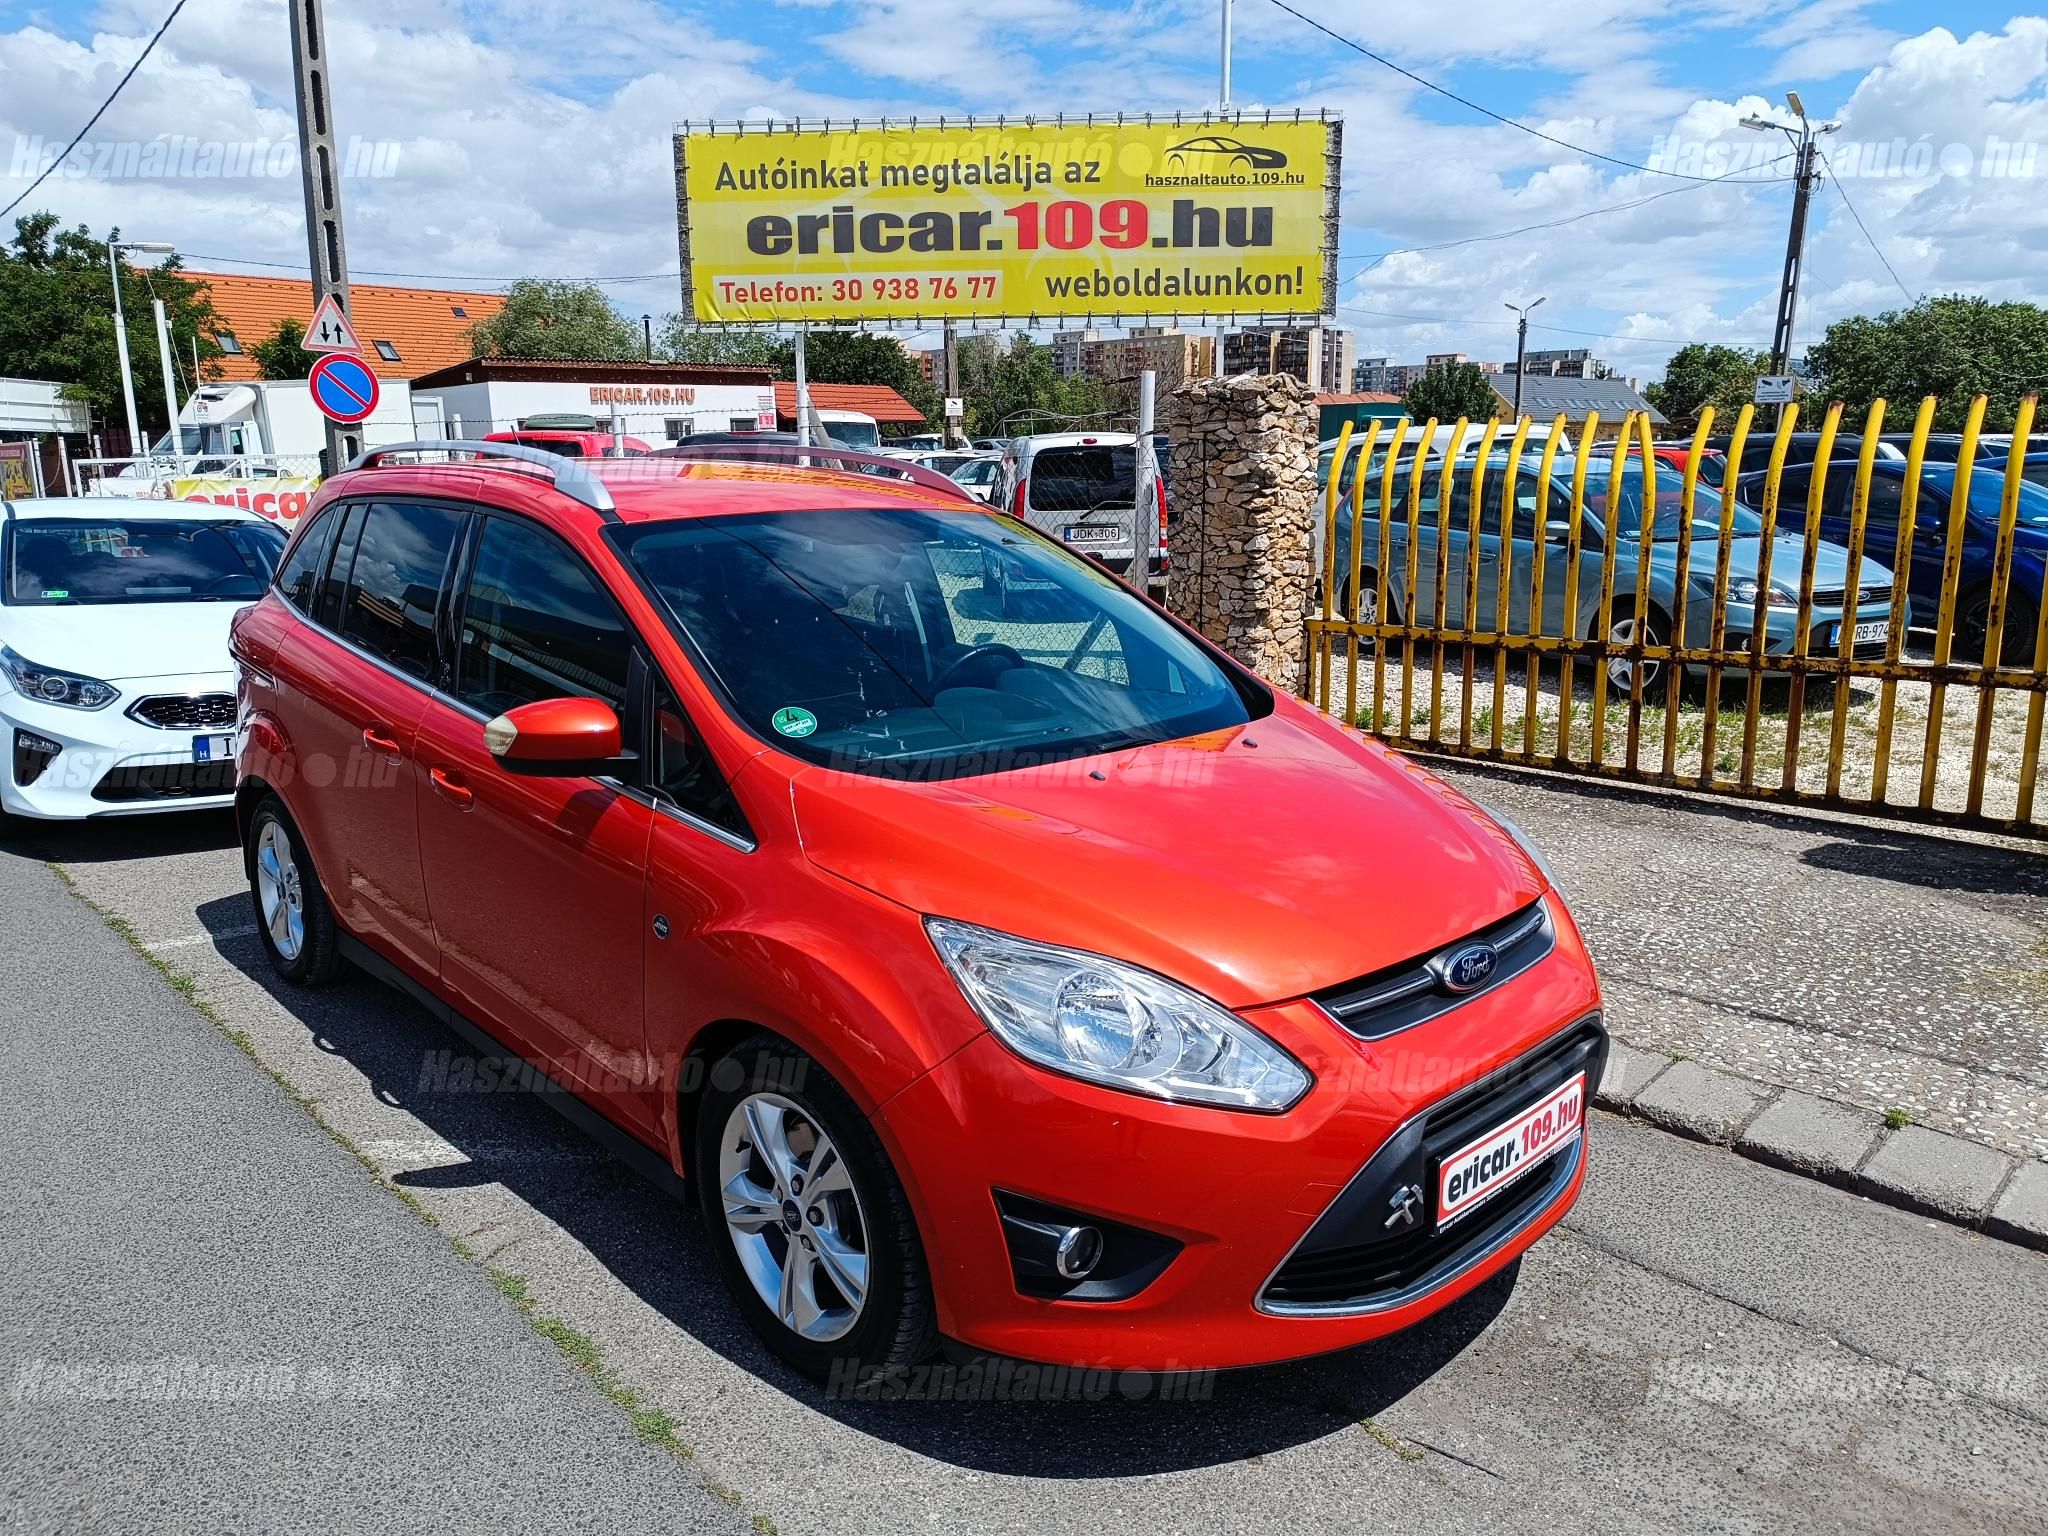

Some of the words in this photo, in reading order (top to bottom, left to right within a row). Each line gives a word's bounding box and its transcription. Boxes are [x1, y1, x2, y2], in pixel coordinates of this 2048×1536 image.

[715, 157, 869, 191] Autóinkat
[881, 151, 1052, 193] megtalálja
[1064, 161, 1100, 183] az
[1145, 172, 1305, 186] hasznaltauto.109.hu
[747, 199, 1273, 256] ericar.109.hu
[719, 281, 823, 303] Telefon:
[832, 279, 863, 301] 30
[872, 278, 919, 300] 938
[929, 277, 957, 299] 76
[967, 276, 996, 298] 77
[1045, 265, 1303, 297] weboldalunkon!
[590, 386, 695, 405] ERICAR.109.HU
[1072, 528, 1117, 539] JDK-306
[1461, 952, 1490, 982] Ford
[1448, 1094, 1578, 1203] ericar.109.hu
